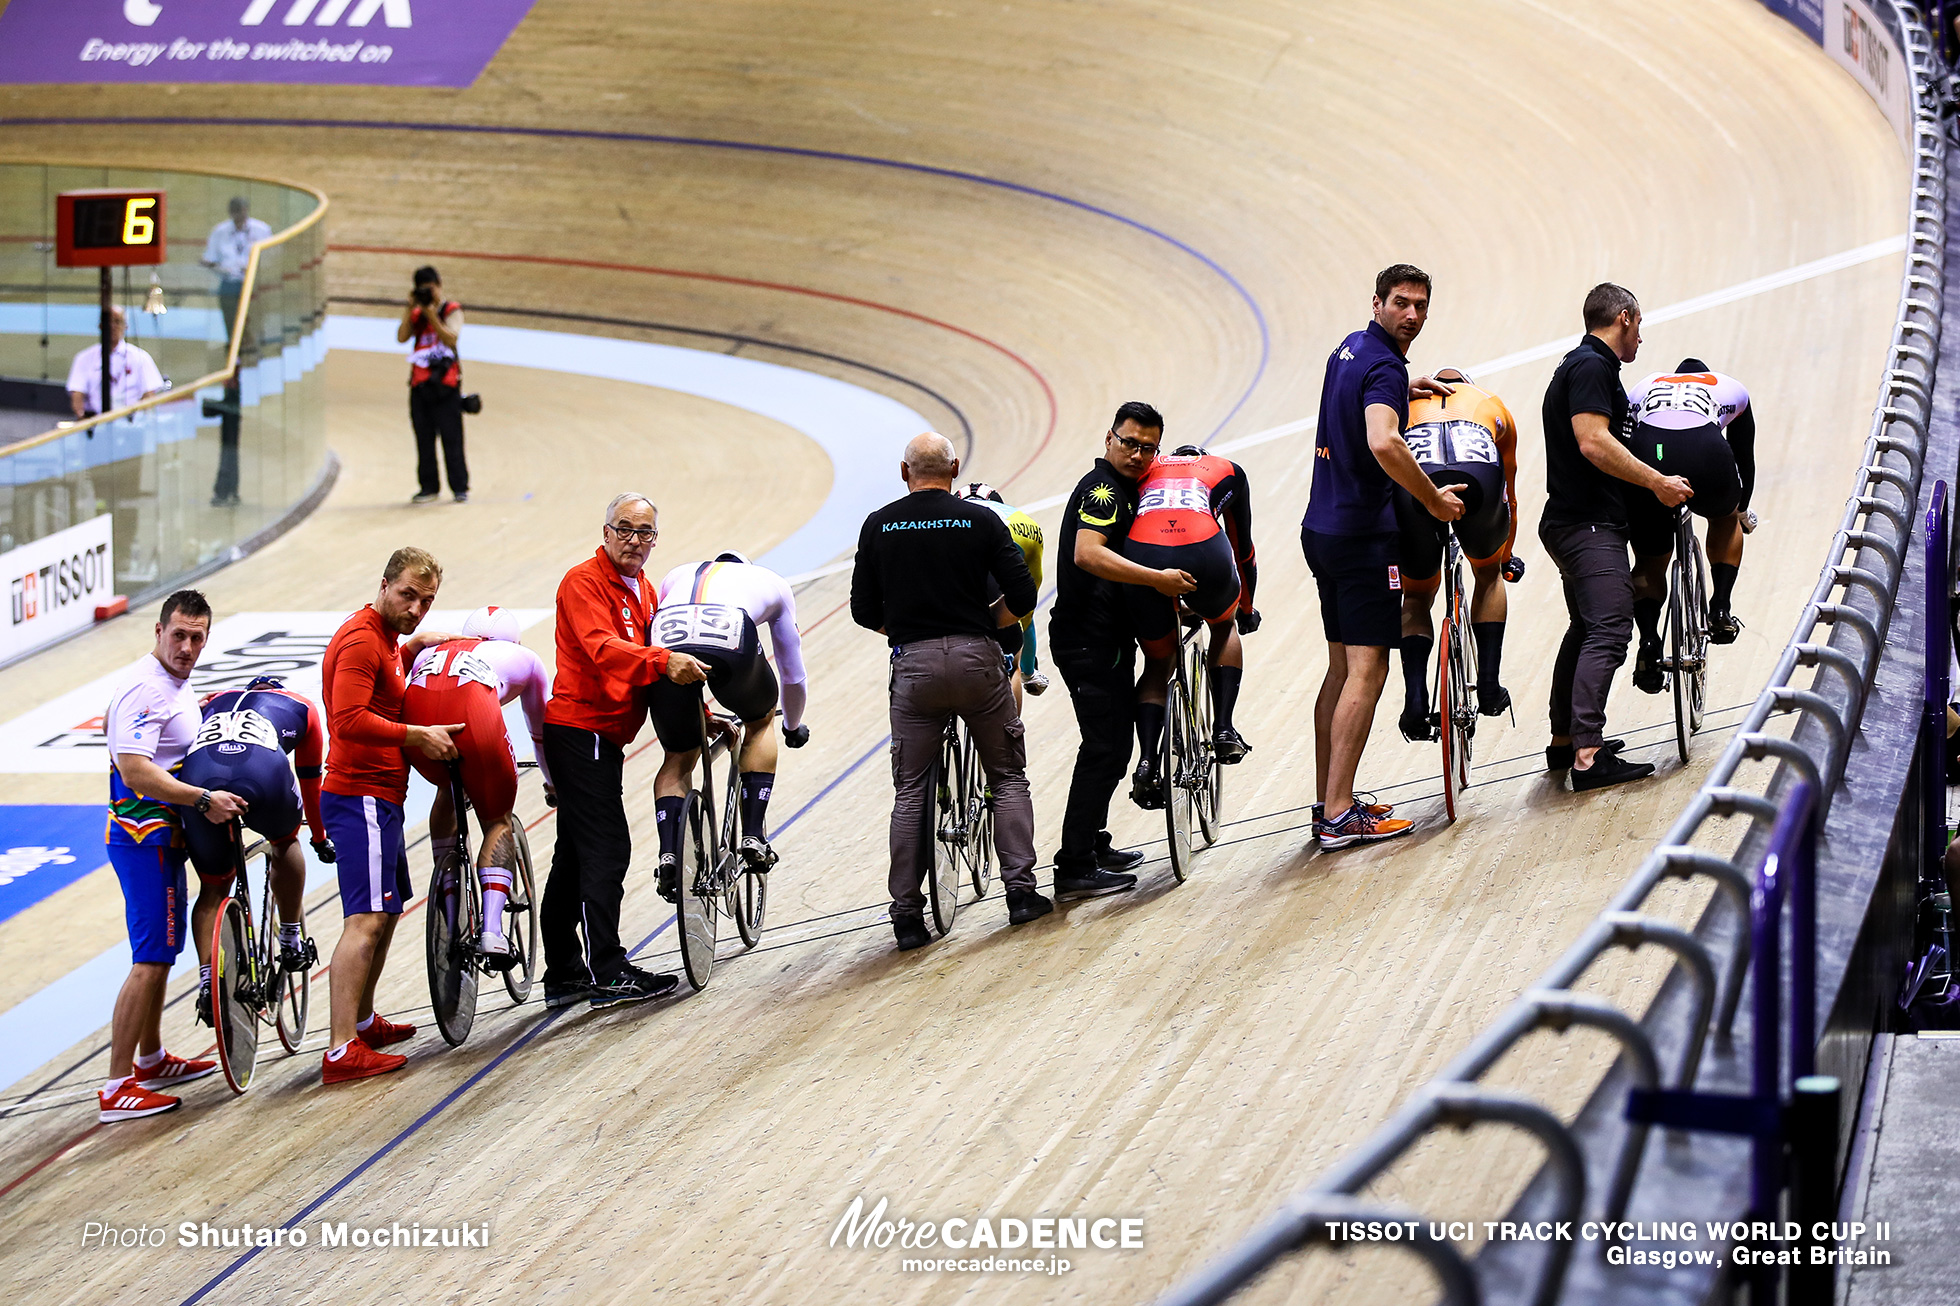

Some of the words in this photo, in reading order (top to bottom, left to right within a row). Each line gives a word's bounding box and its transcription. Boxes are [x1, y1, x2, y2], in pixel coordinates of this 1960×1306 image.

[79, 37, 168, 66] Energy
[166, 36, 208, 61] for
[206, 36, 250, 62] the
[249, 37, 365, 63] switched
[358, 45, 394, 63] on
[122, 197, 156, 245] 6
[1457, 427, 1491, 462] 235
[882, 518, 972, 533] KAZAKHSTAN
[39, 543, 107, 613] TISSOT
[660, 610, 689, 644] 160
[698, 608, 732, 641] 160
[166, 886, 176, 947] BELARUS
